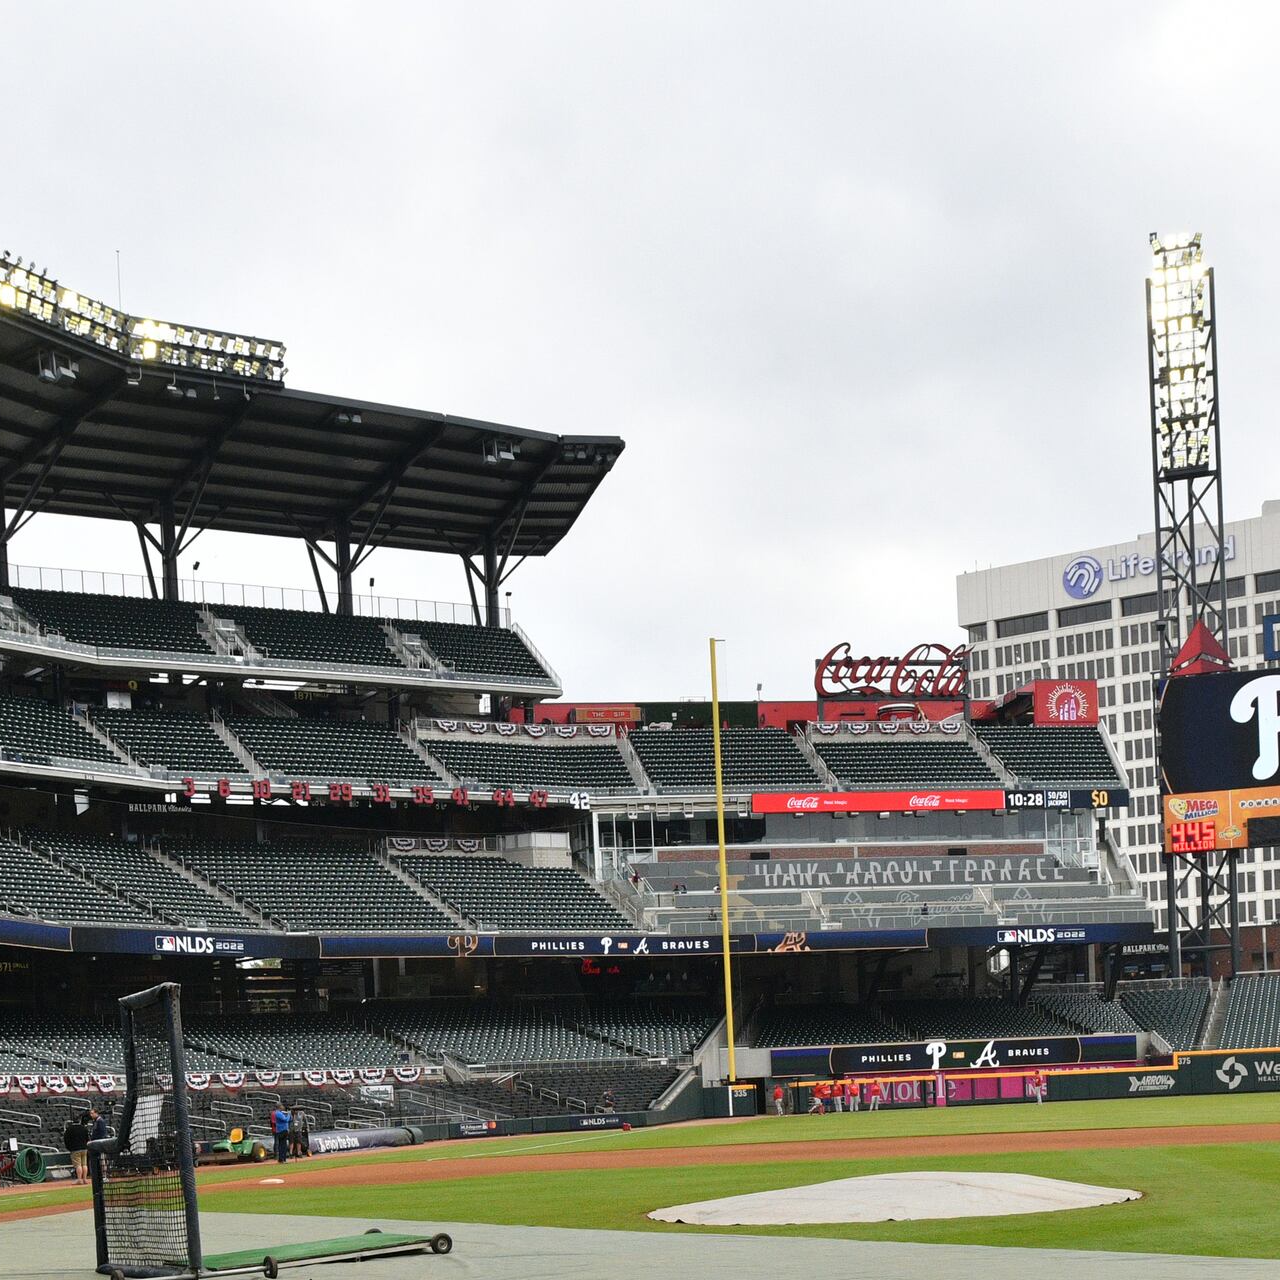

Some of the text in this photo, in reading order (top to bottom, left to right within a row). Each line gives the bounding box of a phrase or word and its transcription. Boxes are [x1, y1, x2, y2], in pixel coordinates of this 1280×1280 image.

[814, 642, 974, 697] Coca-Cola
[183, 778, 590, 809] 3 6 10 21 29 31 35 41 44 47 42
[1007, 793, 1043, 807] 10:28
[1048, 791, 1068, 801] 50/50
[1091, 790, 1108, 807] $0
[129, 804, 167, 813] BALLPARK
[1186, 799, 1218, 812] MEGA
[1172, 821, 1215, 844] 445
[1173, 840, 1215, 852] MILLION
[755, 858, 1064, 887] HANK AARON TERRACE
[1017, 928, 1055, 943] NLDS
[175, 937, 244, 953] NLDS 2022
[531, 941, 585, 951] PHILLIES
[662, 940, 710, 950] BRAVES
[1122, 944, 1156, 953] BALLPARK
[862, 1054, 911, 1063] PHILLIES
[1008, 1048, 1049, 1057] BRAVES
[1141, 1075, 1168, 1086] ARROW
[734, 1090, 747, 1098] 335
[589, 1118, 606, 1126] NLDS
